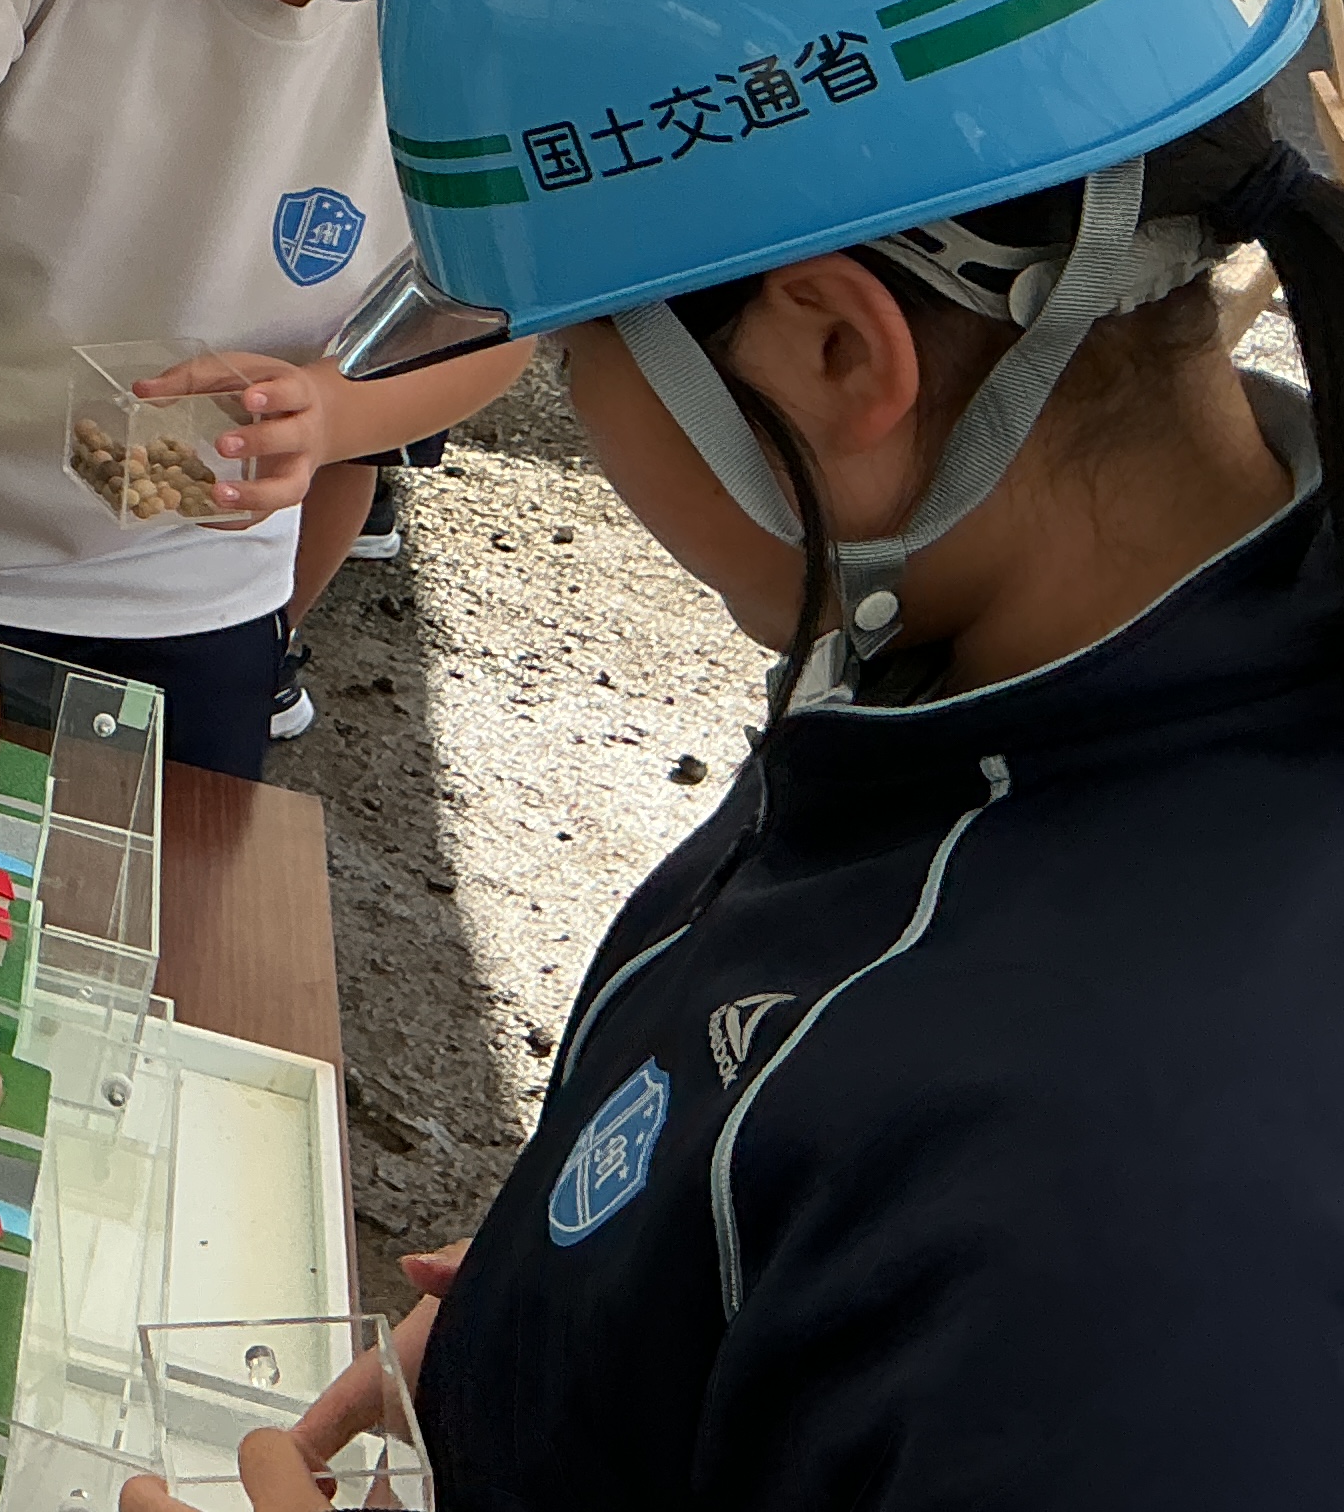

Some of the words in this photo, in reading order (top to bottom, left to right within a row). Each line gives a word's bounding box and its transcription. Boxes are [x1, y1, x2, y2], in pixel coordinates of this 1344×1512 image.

[522, 30, 878, 192] 国土交通省
